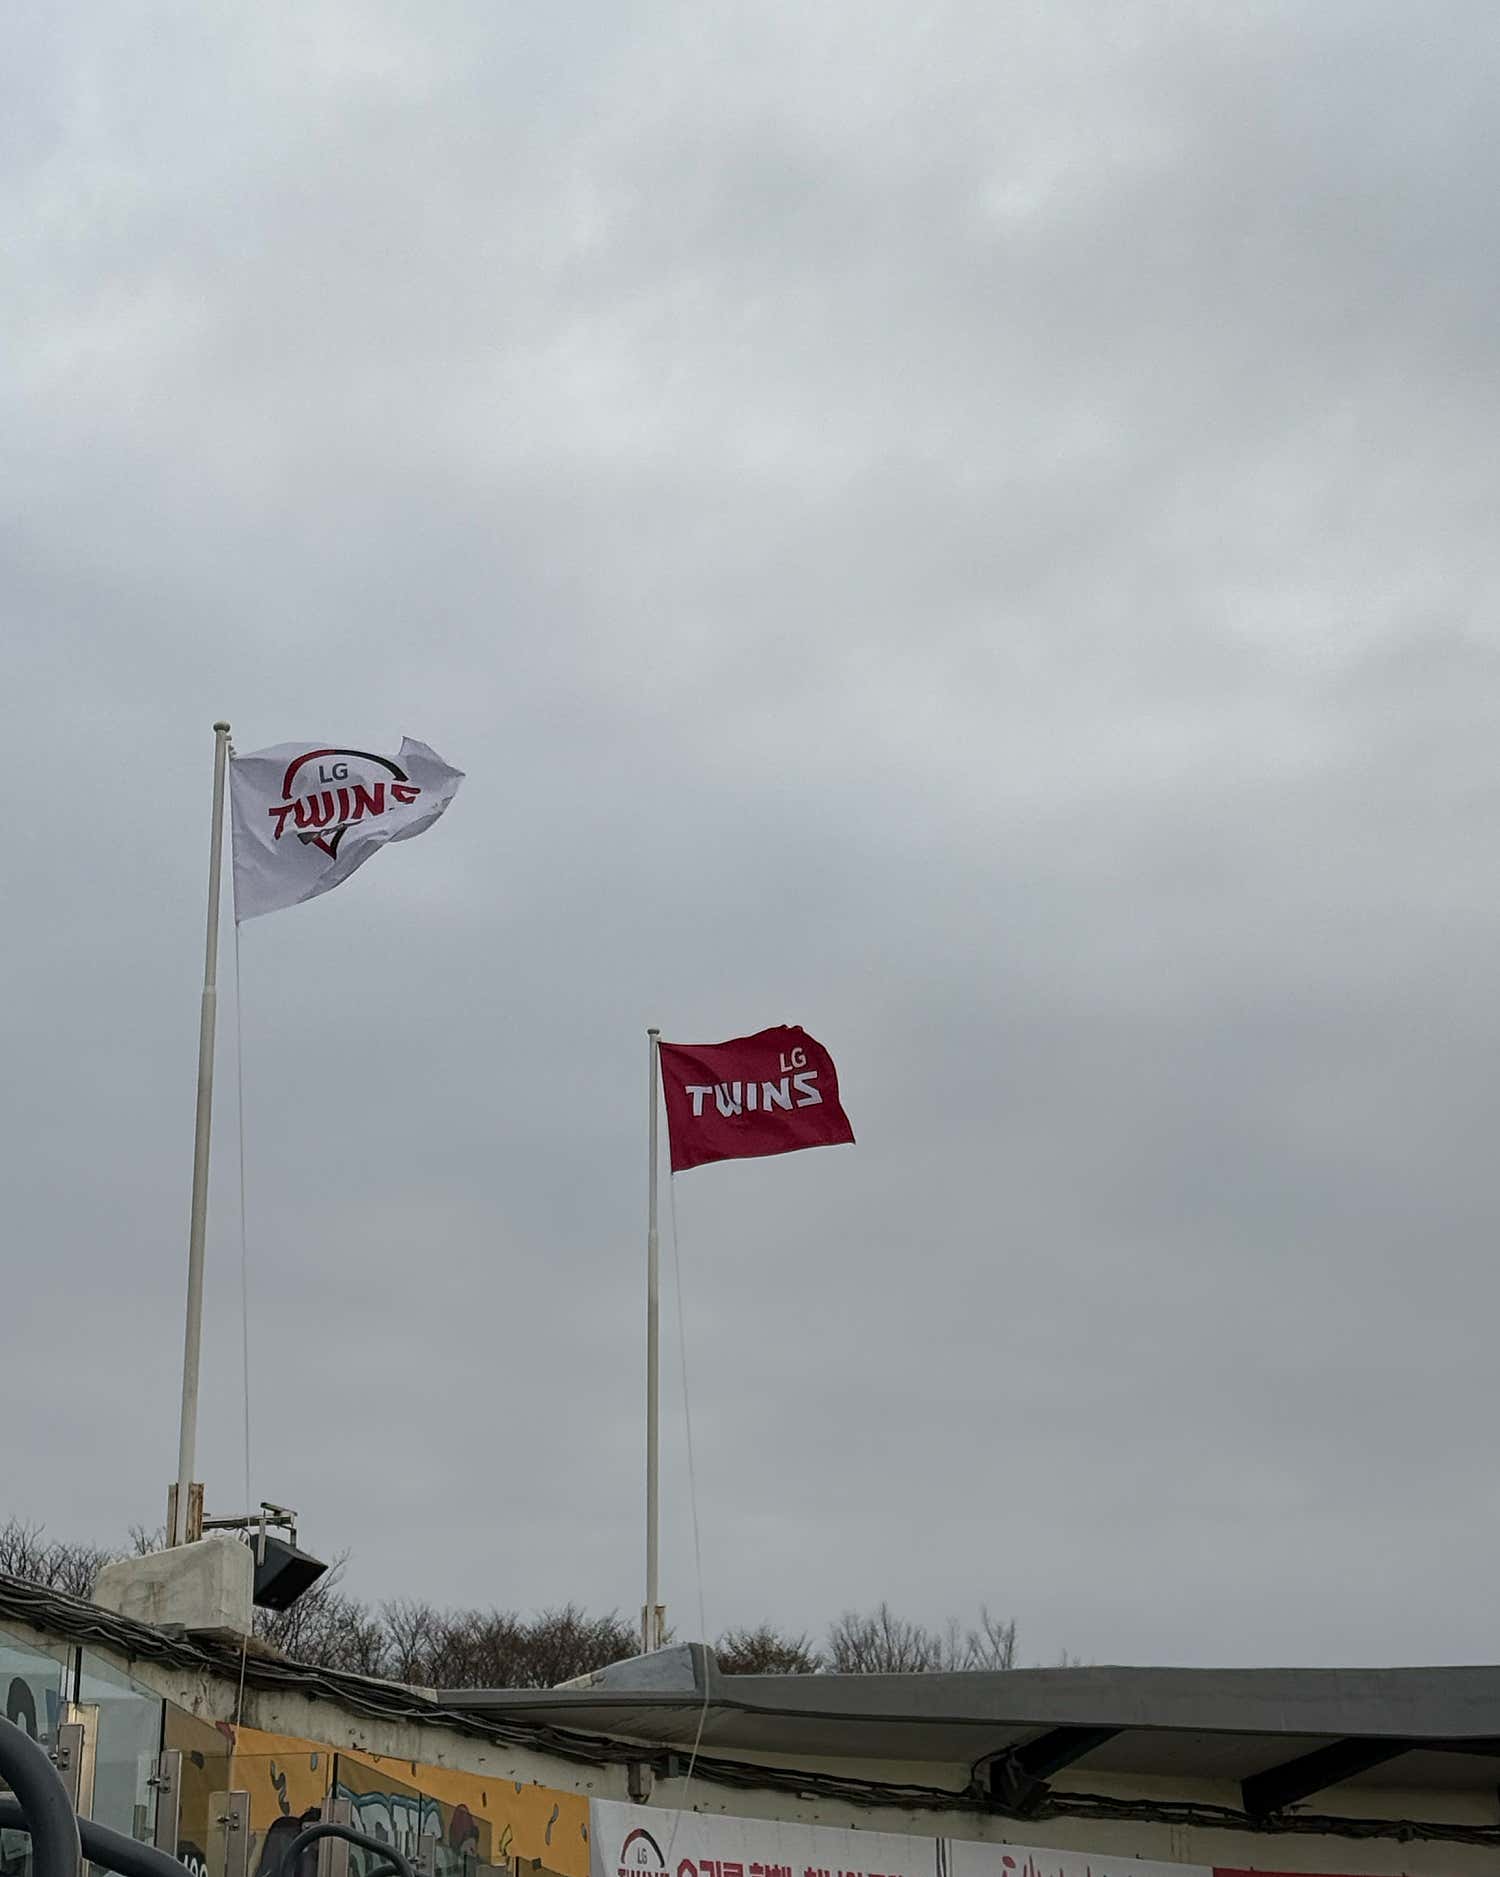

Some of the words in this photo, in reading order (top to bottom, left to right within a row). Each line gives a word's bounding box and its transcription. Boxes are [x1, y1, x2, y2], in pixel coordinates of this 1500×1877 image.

[319, 763, 348, 783] LG
[780, 1047, 806, 1073] LG
[685, 1070, 823, 1118] TWINS
[637, 1847, 648, 1865] LG
